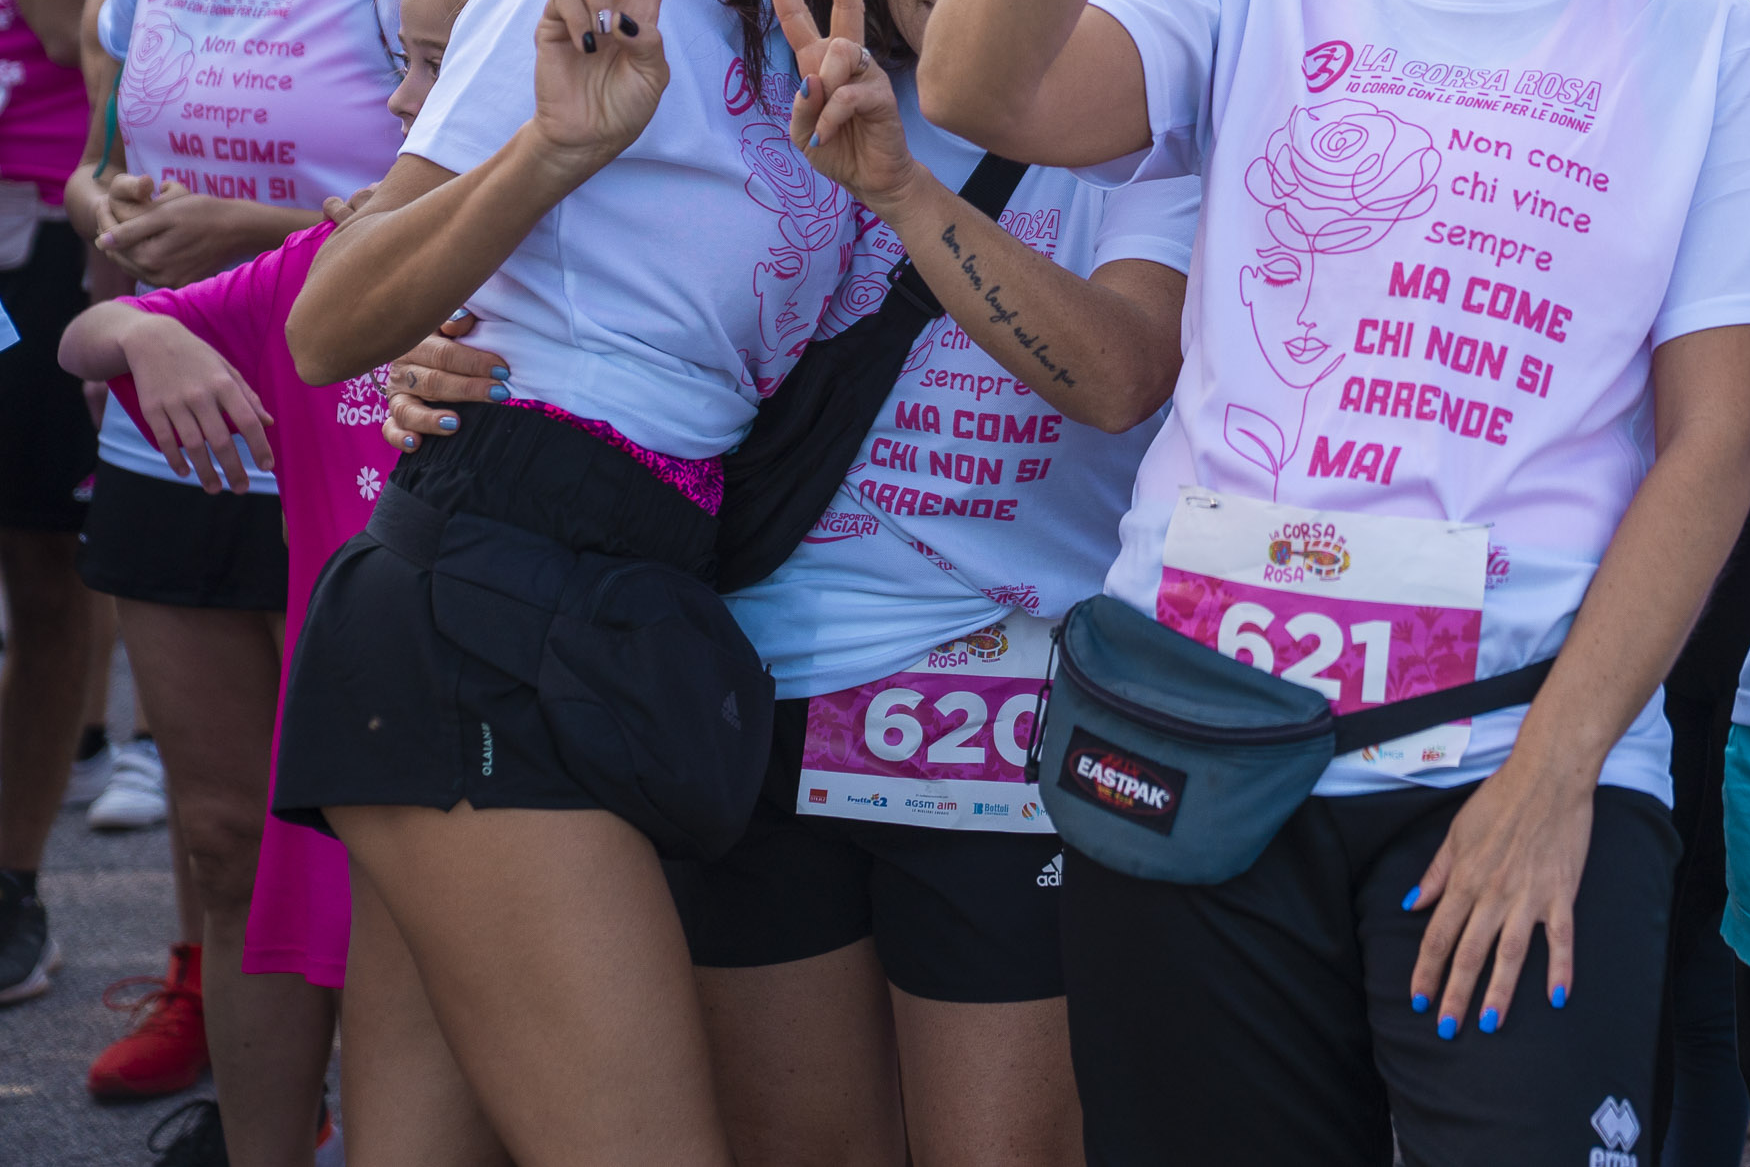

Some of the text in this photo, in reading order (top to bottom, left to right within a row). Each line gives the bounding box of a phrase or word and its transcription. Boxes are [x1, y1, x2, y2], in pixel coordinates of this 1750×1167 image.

[200, 35, 305, 57] Non come
[195, 66, 293, 91] chi vince
[1353, 44, 1601, 112] LA CORSA ROSA
[180, 101, 268, 128] sempre
[1345, 81, 1594, 134] IO CORRO CON LE DONNE PER LE DONNE
[168, 131, 296, 165] MA COME
[1447, 128, 1610, 192] Non come
[203, 173, 257, 200] NON
[268, 178, 296, 201] SI
[1451, 171, 1592, 234] chi vince
[872, 237, 883, 249] IO
[1425, 220, 1553, 272] sempre
[1388, 261, 1573, 343] MA COME
[1354, 318, 1554, 398] CHI NON SI
[920, 368, 1031, 401] sempre
[337, 402, 384, 426] ROSA
[894, 400, 1063, 445] MA COME
[1339, 376, 1513, 446] ARRENDE
[870, 437, 1052, 486] CHI NON SI
[1307, 435, 1402, 486] MAI
[858, 478, 1018, 522] ARRENDE
[812, 518, 880, 536] NGIARI
[1283, 522, 1336, 540] CORSA
[1263, 564, 1304, 583] ROSA
[928, 651, 968, 668] ROSA
[1217, 600, 1392, 704] 621
[864, 687, 1047, 768] 620
[1077, 754, 1167, 809] EASTPAK
